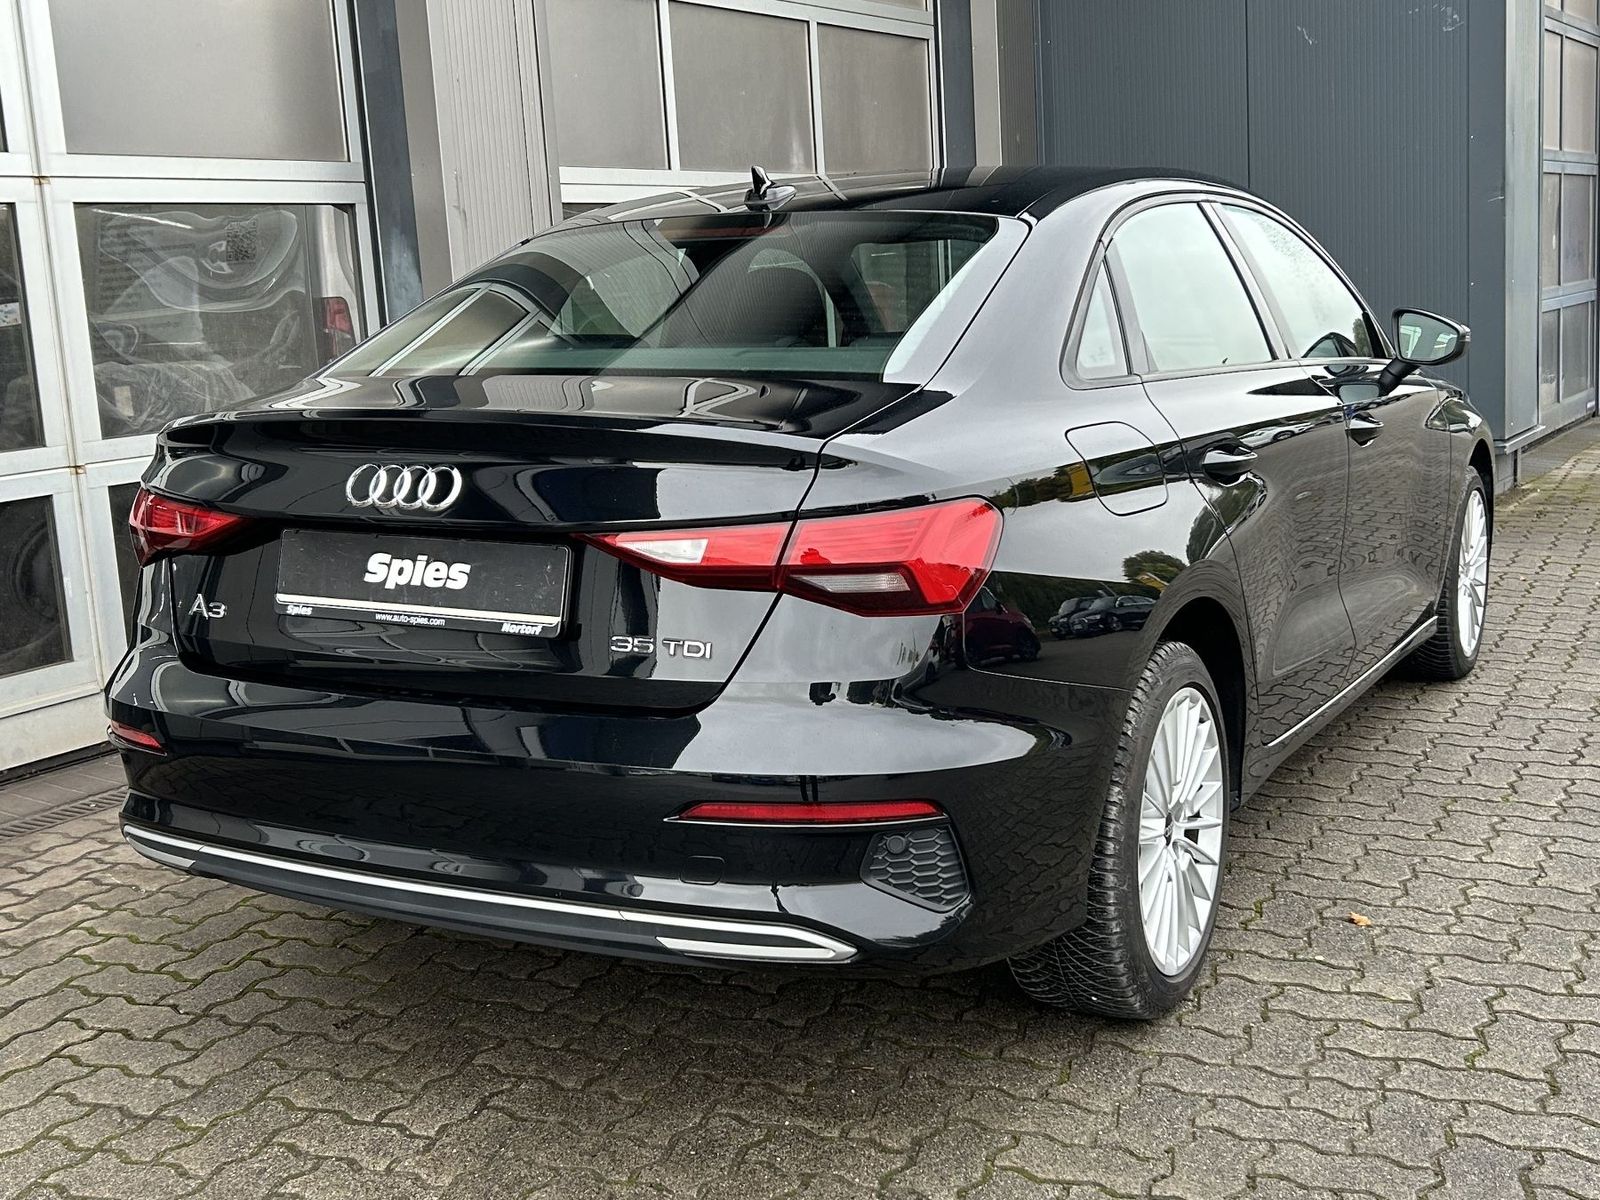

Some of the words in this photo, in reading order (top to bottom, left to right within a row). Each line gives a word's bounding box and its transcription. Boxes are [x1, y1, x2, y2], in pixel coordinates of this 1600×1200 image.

[364, 552, 472, 590] Spies
[188, 593, 226, 620] A3
[286, 604, 313, 616] Spies
[375, 613, 446, 626] www.auto-spies.com
[501, 622, 543, 636] Nortorf
[610, 635, 654, 654] 35
[662, 639, 712, 659] TDI
